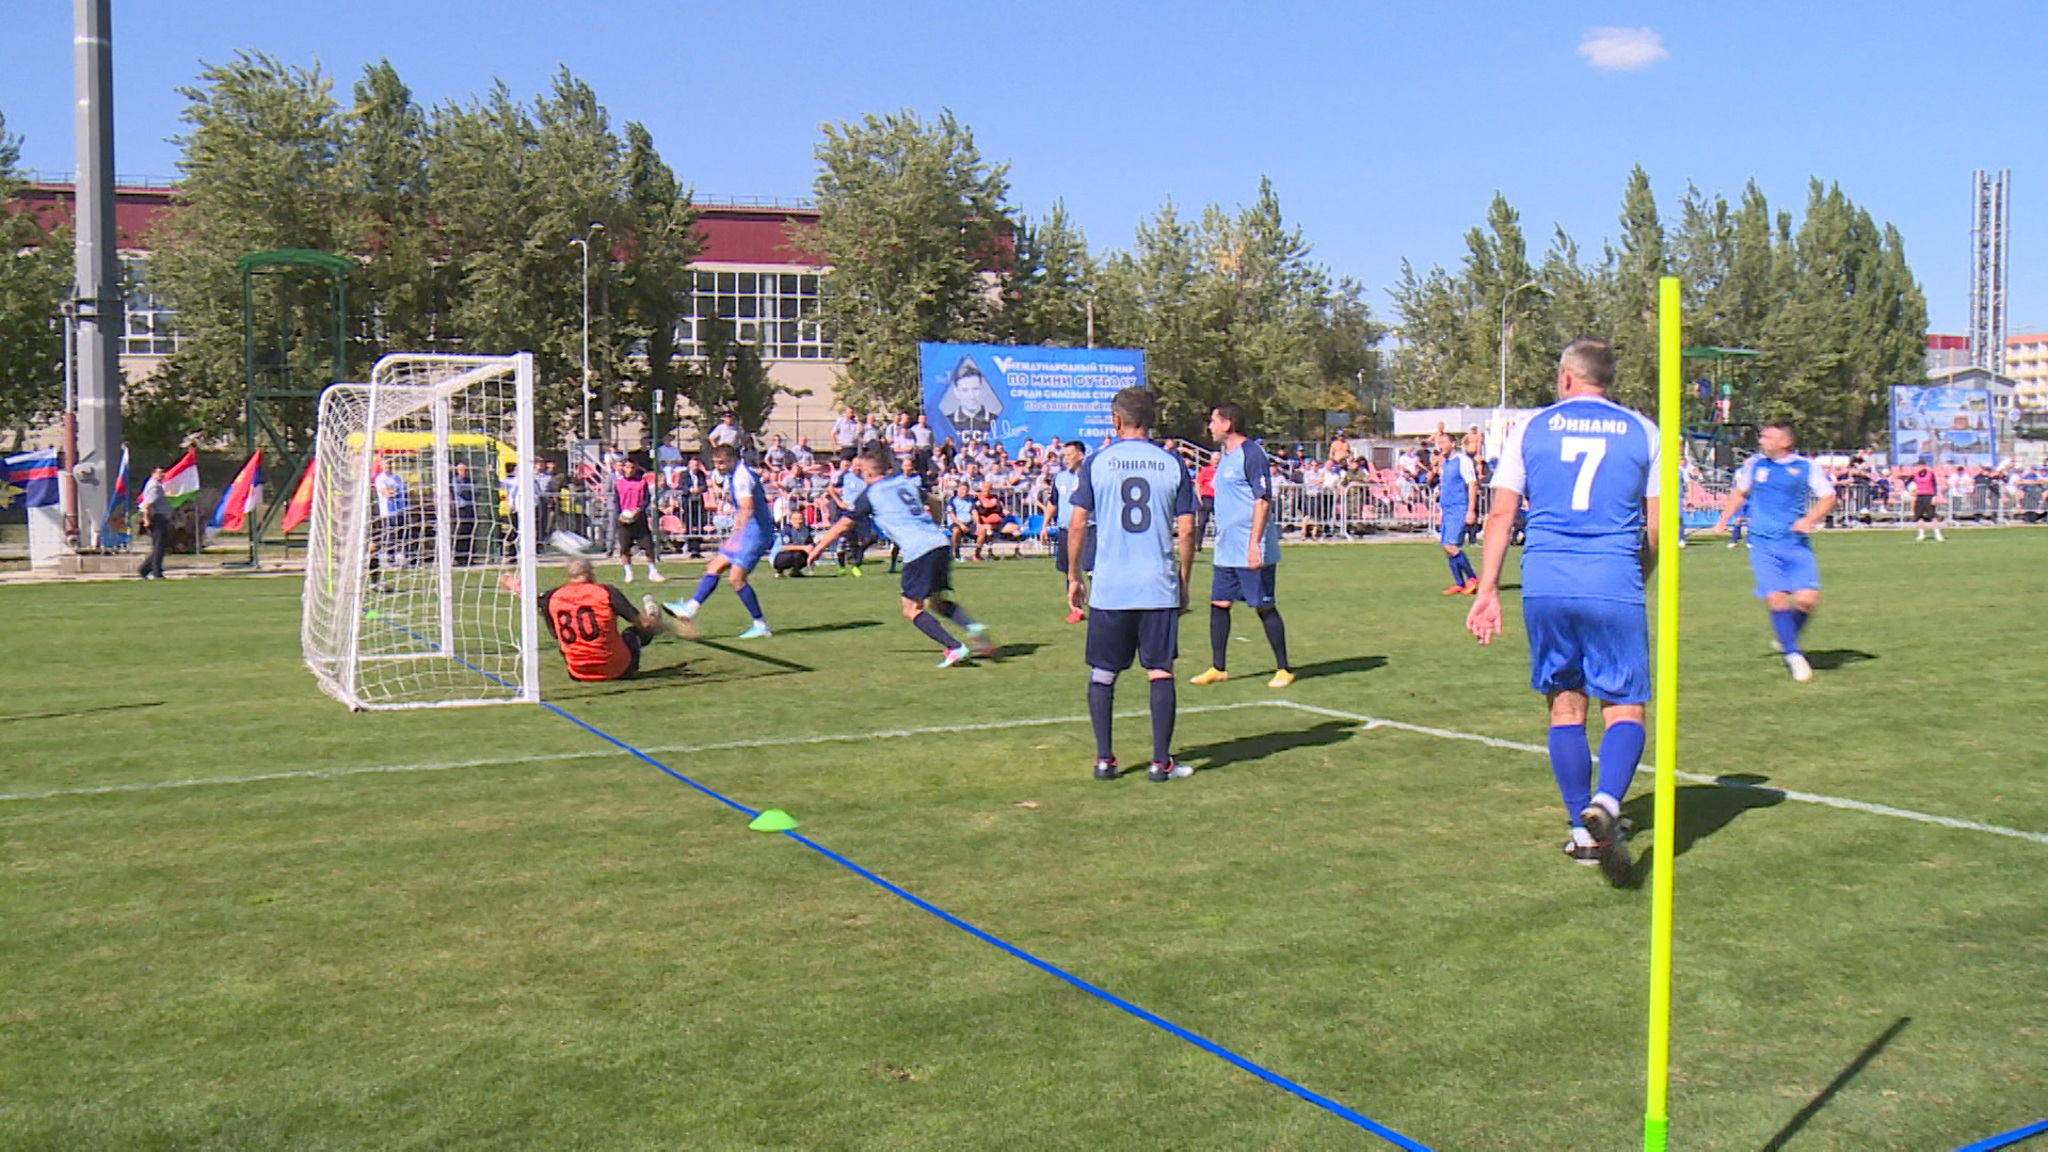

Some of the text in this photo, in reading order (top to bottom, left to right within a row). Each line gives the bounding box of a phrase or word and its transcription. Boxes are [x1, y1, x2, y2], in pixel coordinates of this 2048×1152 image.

[1007, 373, 1137, 388] ПО МИНИ ФУТБОЛУ
[1560, 435, 1607, 511] 7
[1121, 476, 1151, 533] 8
[557, 605, 600, 644] 80
